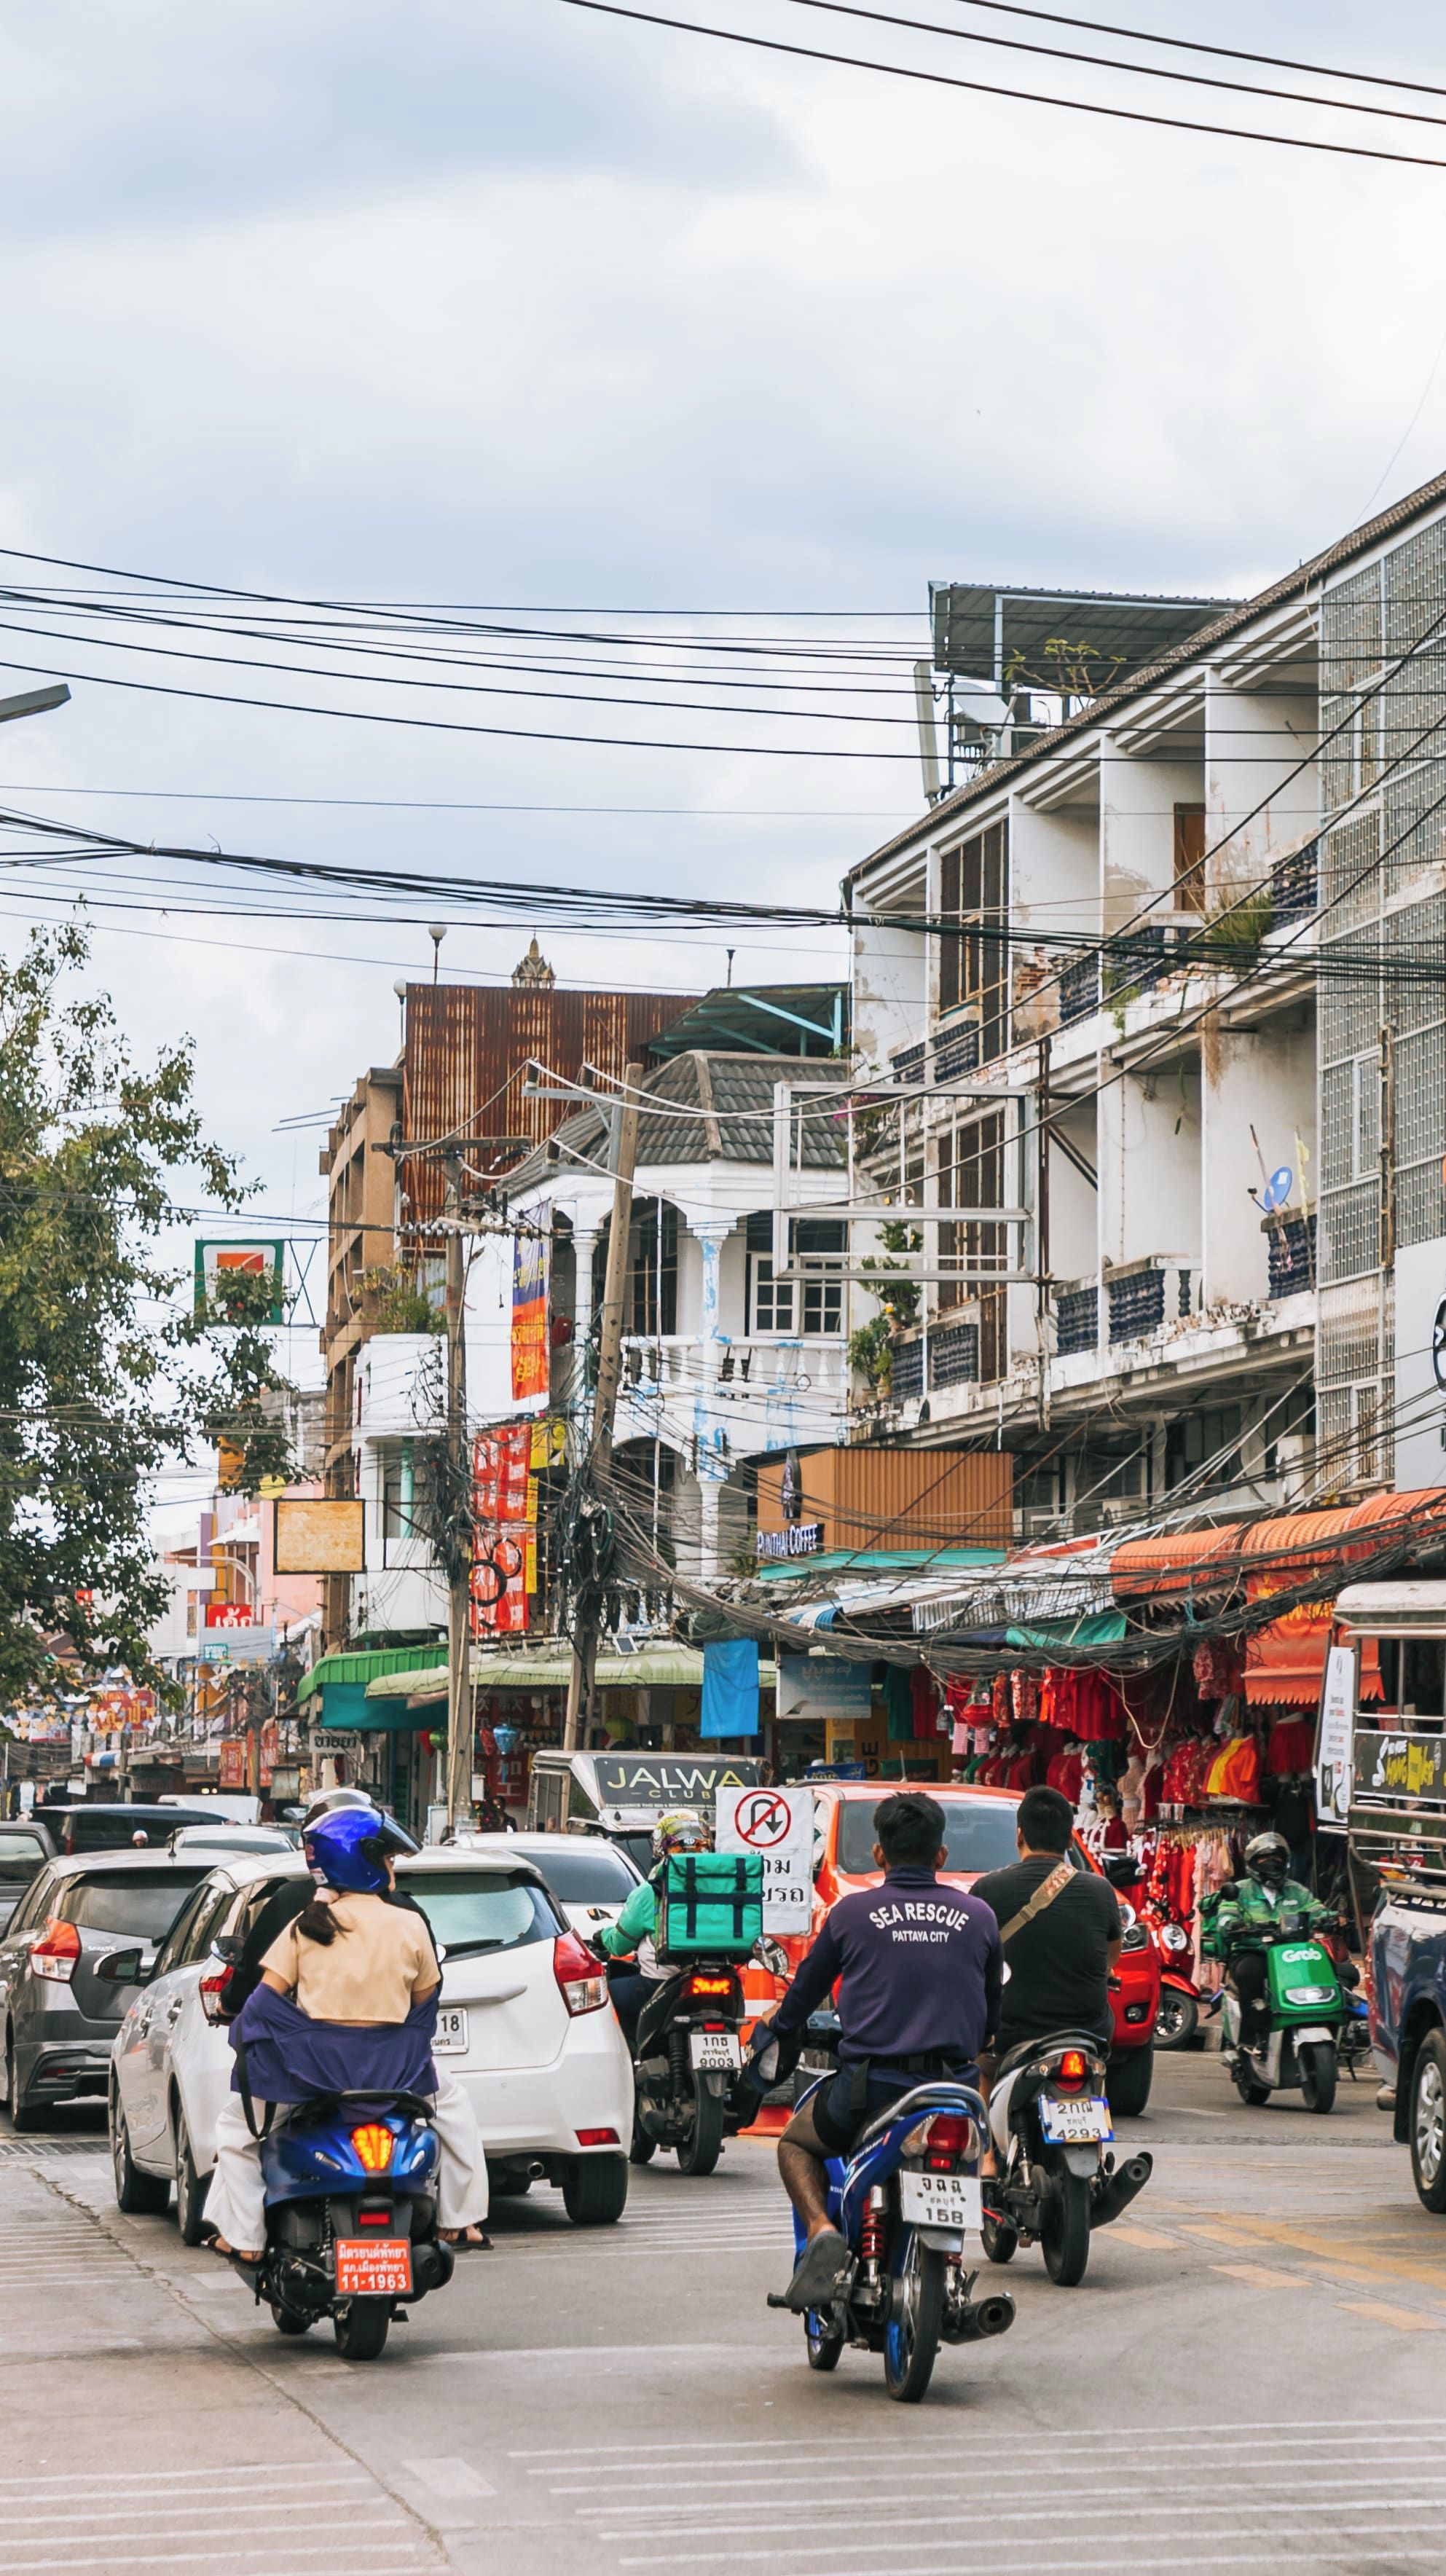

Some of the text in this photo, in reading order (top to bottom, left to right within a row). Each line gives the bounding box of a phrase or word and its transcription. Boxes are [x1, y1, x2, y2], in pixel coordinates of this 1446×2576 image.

[790, 1524, 818, 1555] COFFEE
[607, 1767, 746, 1789] JALWA
[648, 1790, 711, 1799] CLUB
[869, 1902, 970, 1931] SEA RESCUE
[892, 1930, 950, 1944] PATTAYA CITY
[1282, 1947, 1322, 1963] Grab
[700, 2057, 734, 2068] 9003
[1056, 2127, 1102, 2140] 4293
[926, 2207, 963, 2224] 158
[341, 2274, 407, 2290] 11-1963
